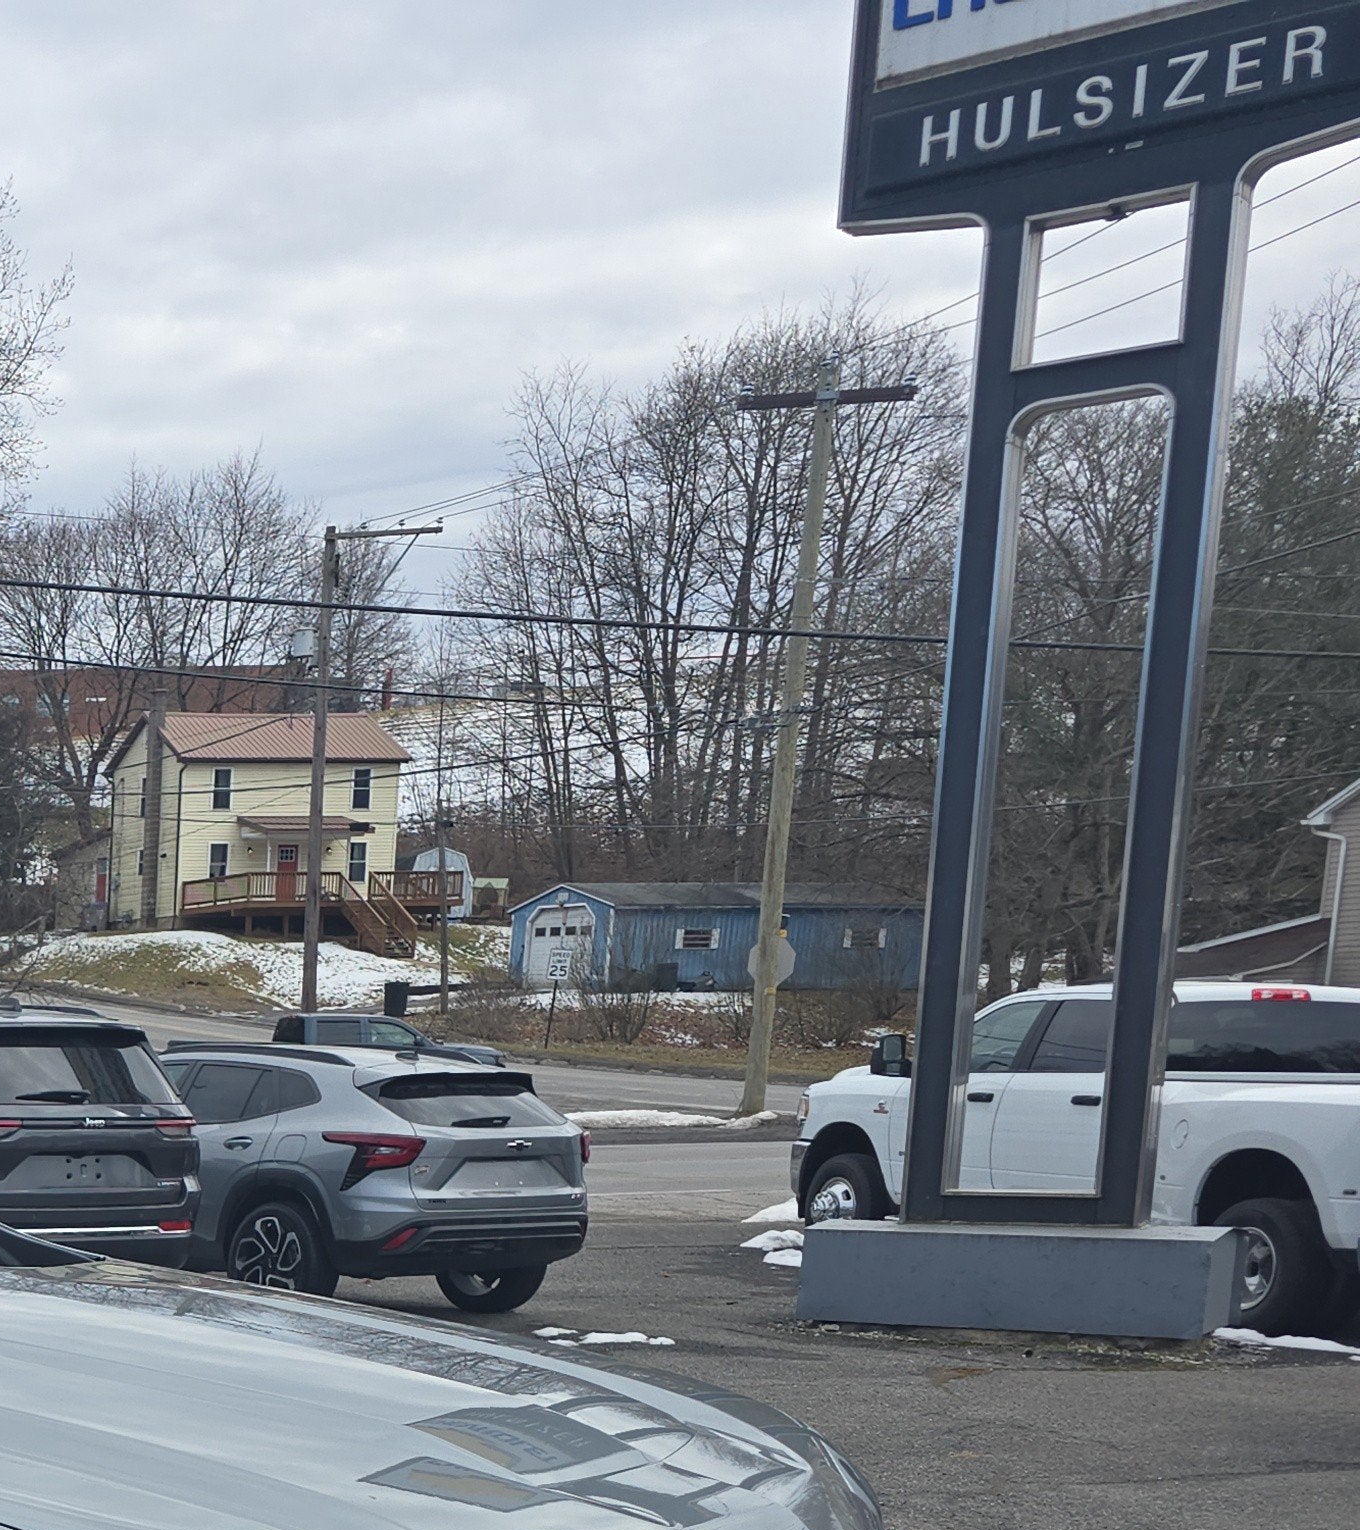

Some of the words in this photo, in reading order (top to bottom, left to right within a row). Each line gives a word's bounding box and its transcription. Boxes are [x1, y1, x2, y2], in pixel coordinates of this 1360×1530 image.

[918, 24, 1328, 168] HULSIZER
[549, 965, 568, 977] 25
[82, 1117, 106, 1128] Jeep
